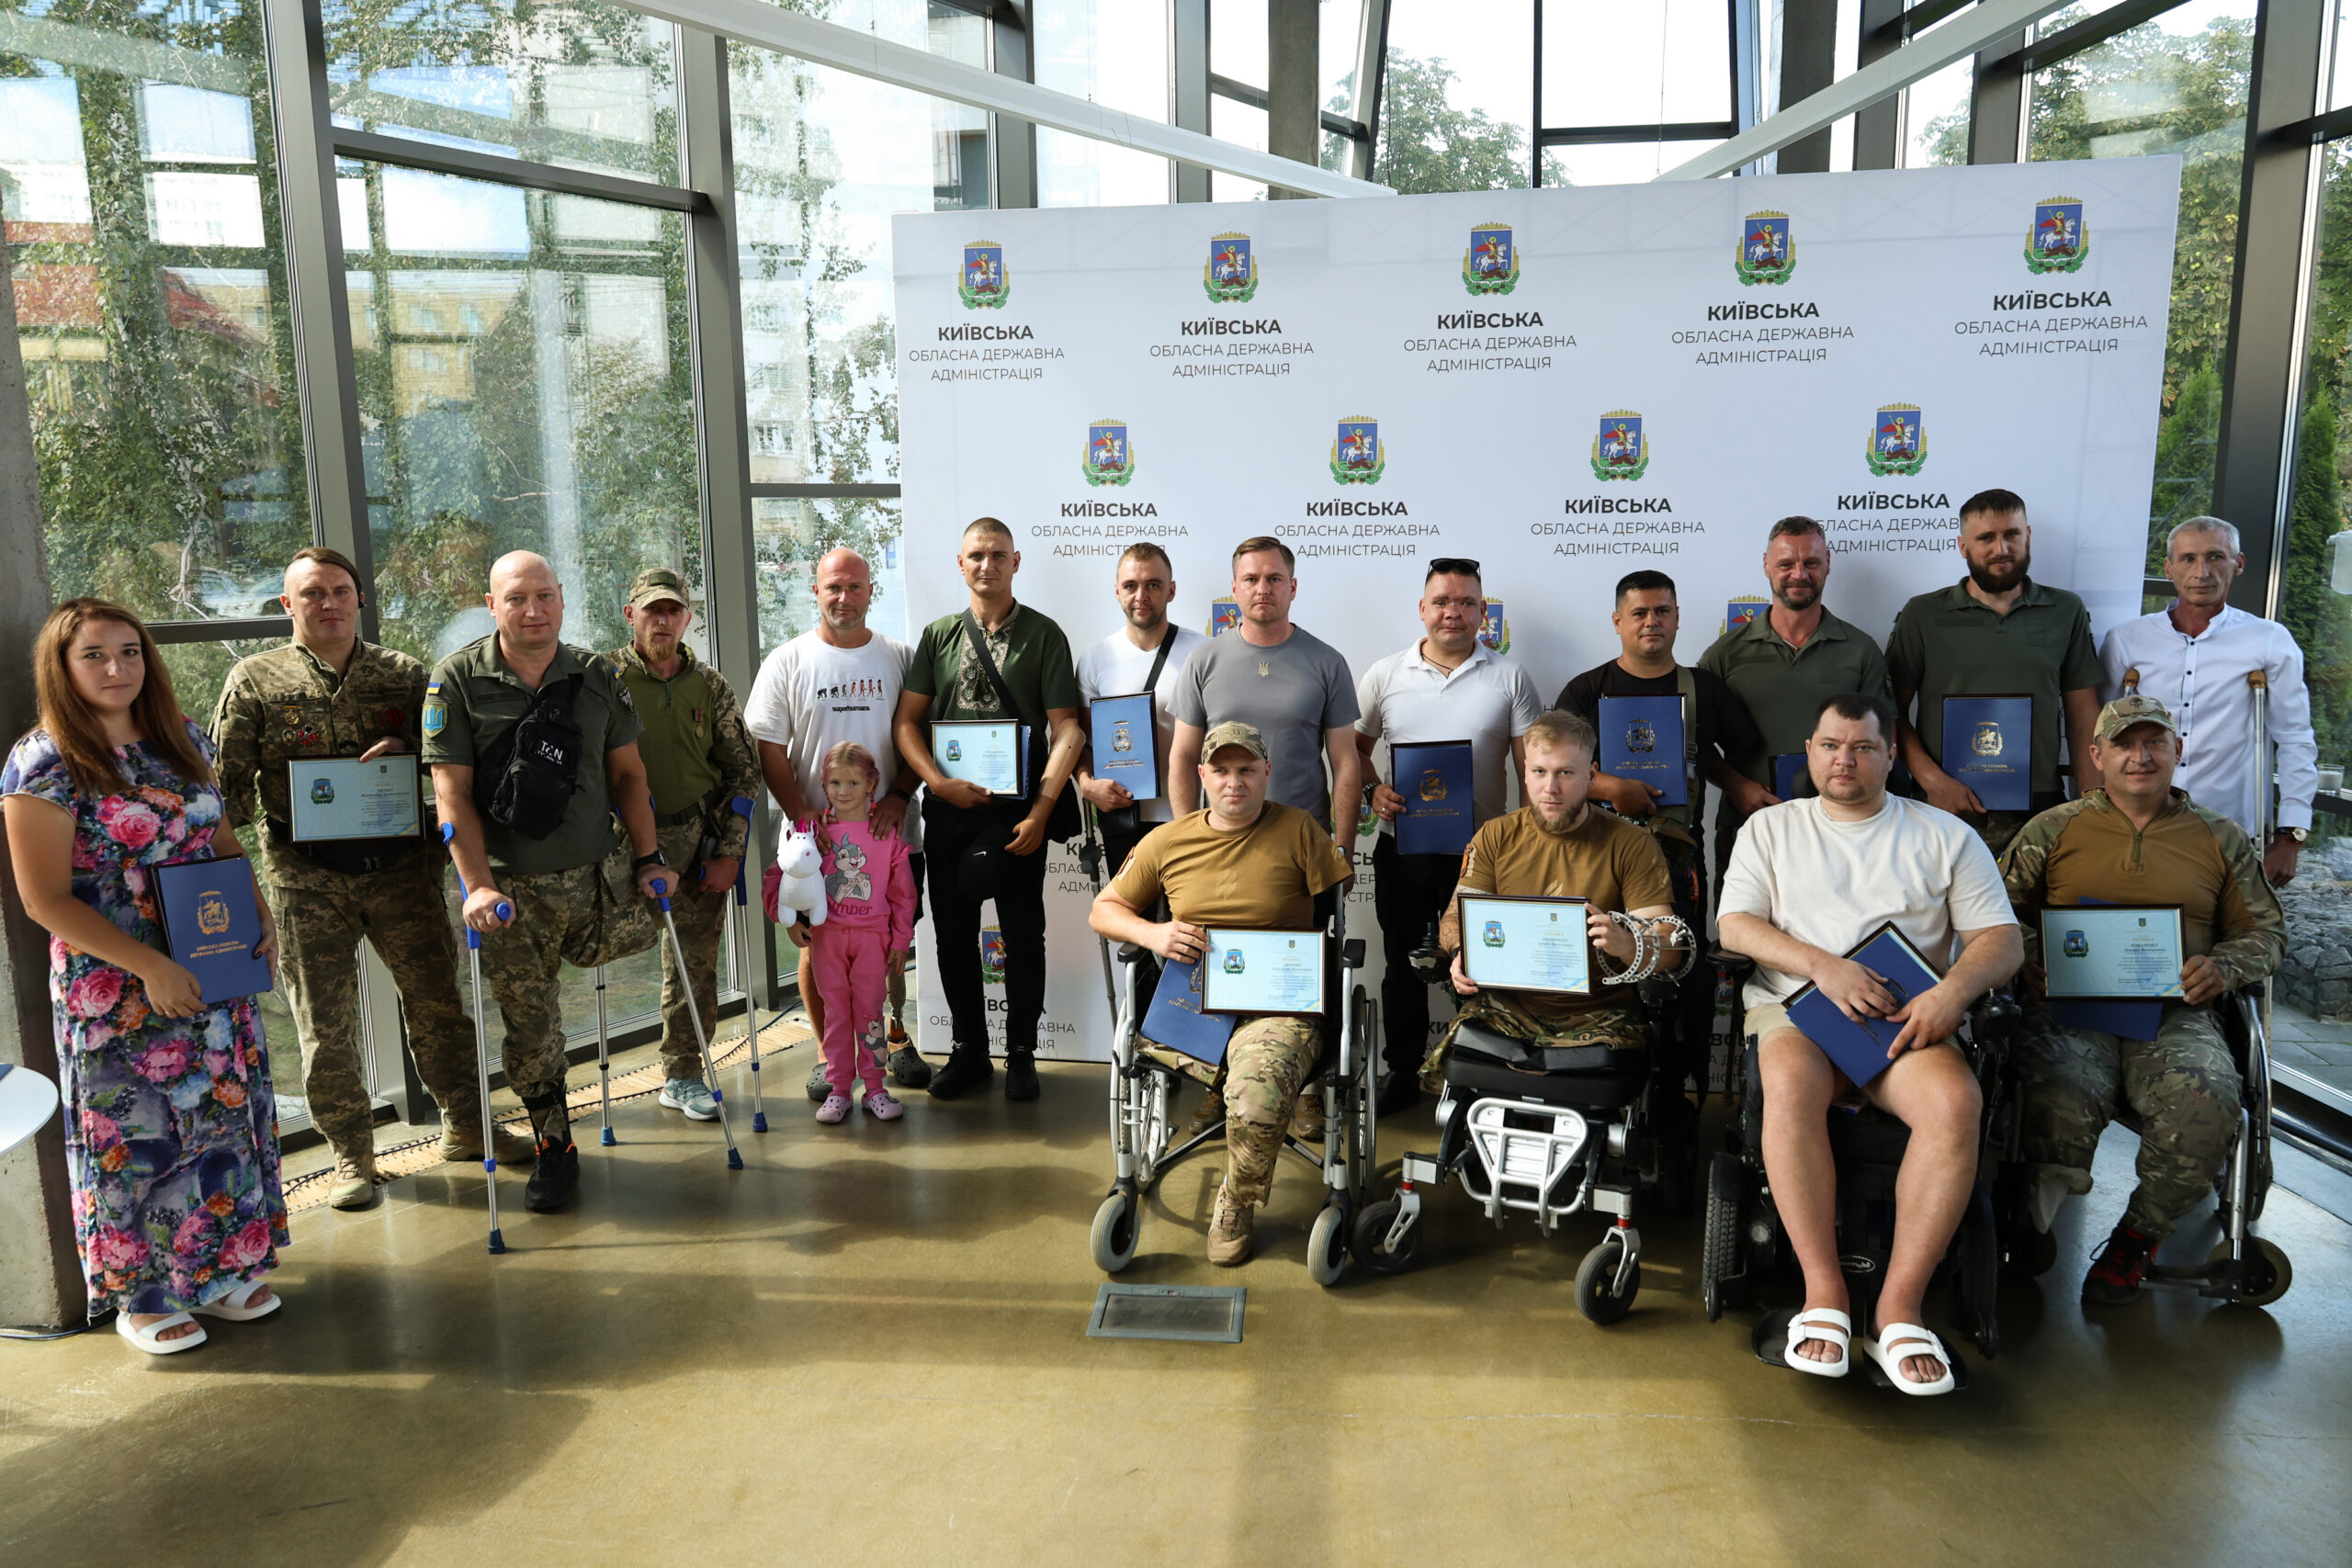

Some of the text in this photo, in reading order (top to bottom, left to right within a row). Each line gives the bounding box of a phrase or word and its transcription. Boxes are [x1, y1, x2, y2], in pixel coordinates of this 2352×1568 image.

[1994, 290, 2112, 310] КИЇВСЬКА
[1708, 301, 1820, 321] КИЇВСЬКА
[1182, 317, 1282, 335] КИЇВСЬКА
[1438, 310, 1544, 330] КИЇВСЬКА
[1955, 316, 2147, 334] ОБЛАСНА ДЕРЖАВНА
[938, 323, 1034, 341] КИЇВСЬКА
[1672, 326, 1854, 344] ОБЛАСНА ДЕРЖАВНА
[1150, 343, 1314, 357] ОБЛАСНА ДЕРЖАВНА
[1404, 335, 1577, 351] ОБЛАСНА ДЕРЖАВНА
[1979, 339, 2118, 357] АДМІНІСТРАЦІЯ
[910, 348, 1064, 362] ОБЛАСНА ДЕРЖАВНА
[1696, 348, 1826, 366] АДМІНІСТРАЦІЯ
[1172, 363, 1289, 378] АДМІНІСТРАЦІЯ
[1428, 356, 1551, 373] АДМІНІСТРАЦІЯ
[931, 368, 1042, 382] АДМІНІСТРАЦІЯ
[1061, 500, 1158, 517] КИЇВСЬКА
[1306, 498, 1408, 516] КИЇВСЬКА
[1566, 495, 1672, 513] КИЇВСЬКА
[1838, 491, 1951, 510] КИЇВСЬКА
[1032, 525, 1188, 538] ОБЛАСНА ДЕРЖАВНА
[1275, 525, 1440, 538] ОБЛАСНА ДЕРЖАВНА
[1531, 522, 1705, 536] ОБЛАСНА ДЕРЖАВНА
[1887, 518, 1959, 533] ДЕРЖАВ
[1297, 544, 1415, 558] АДМІНІСТРАЦІЯ
[1554, 542, 1679, 557] АДМІНІСТРАЦІЯ
[1826, 538, 1957, 554] АДМІНІСТРАЦІЯ
